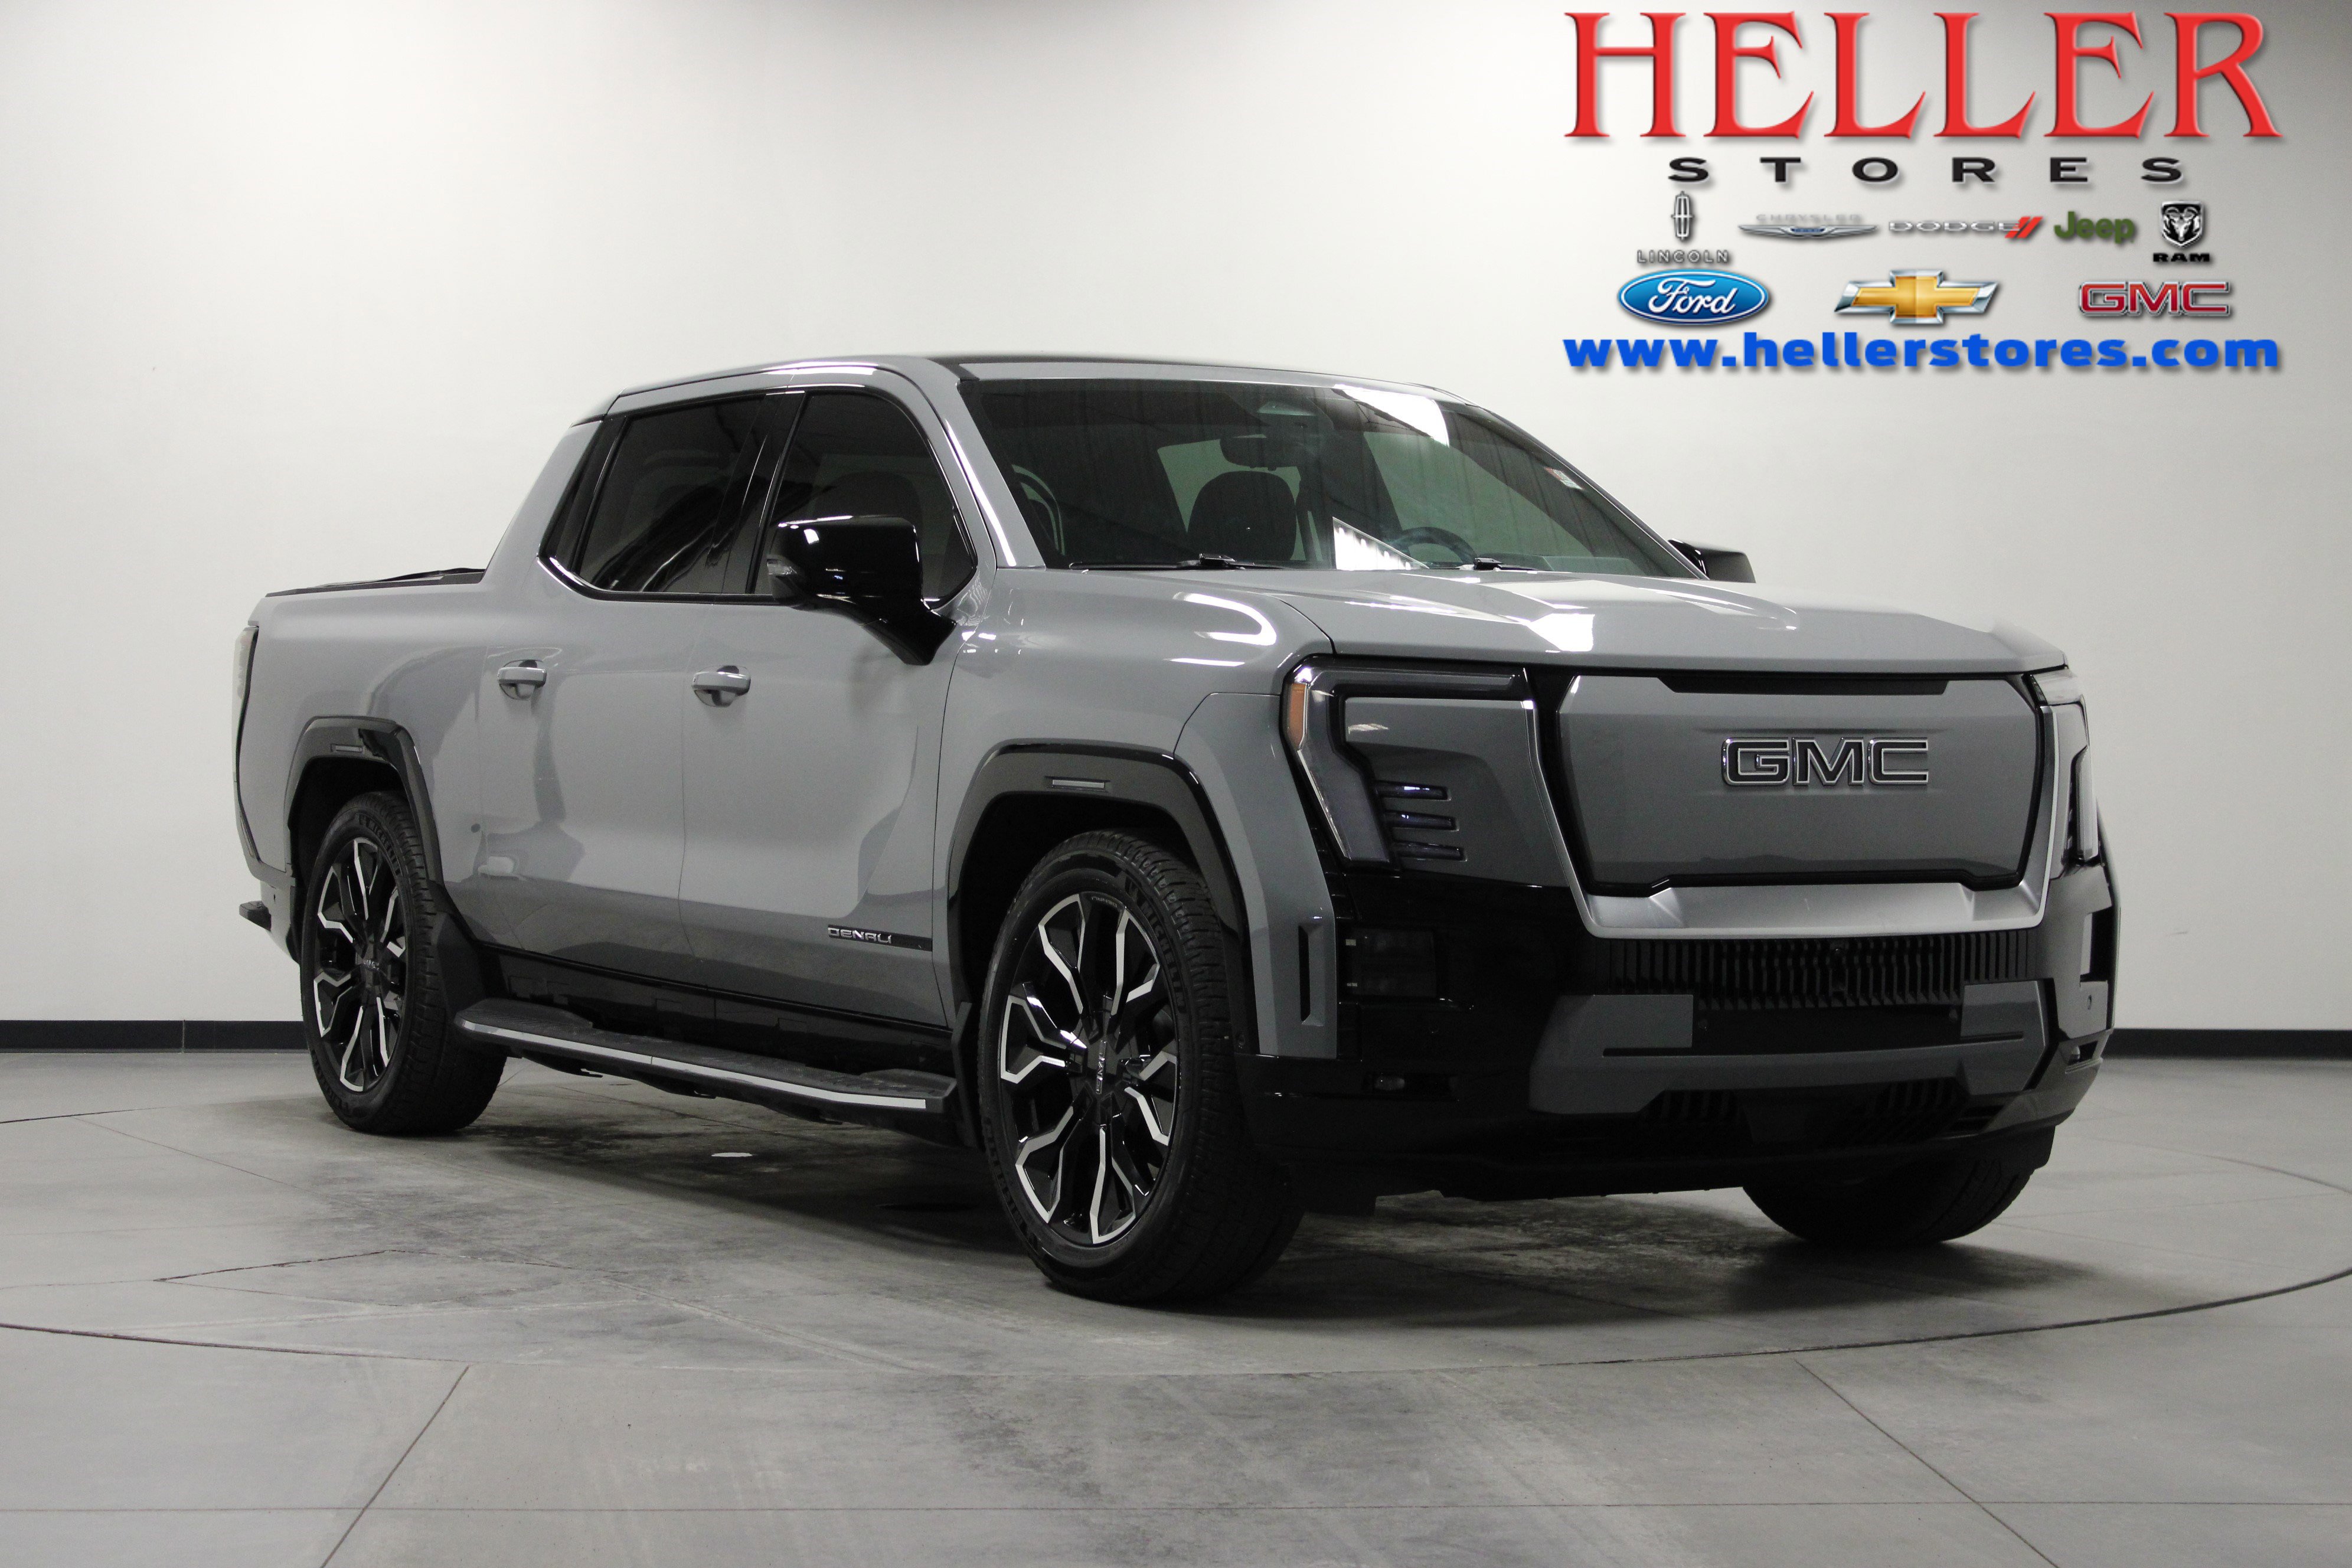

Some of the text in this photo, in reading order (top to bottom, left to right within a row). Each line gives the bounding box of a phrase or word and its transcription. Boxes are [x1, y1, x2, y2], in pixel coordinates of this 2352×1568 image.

[1721, 737, 1929, 786] GMC
[828, 927, 892, 944] DENALI
[1140, 900, 1185, 1007] MICHELIN
